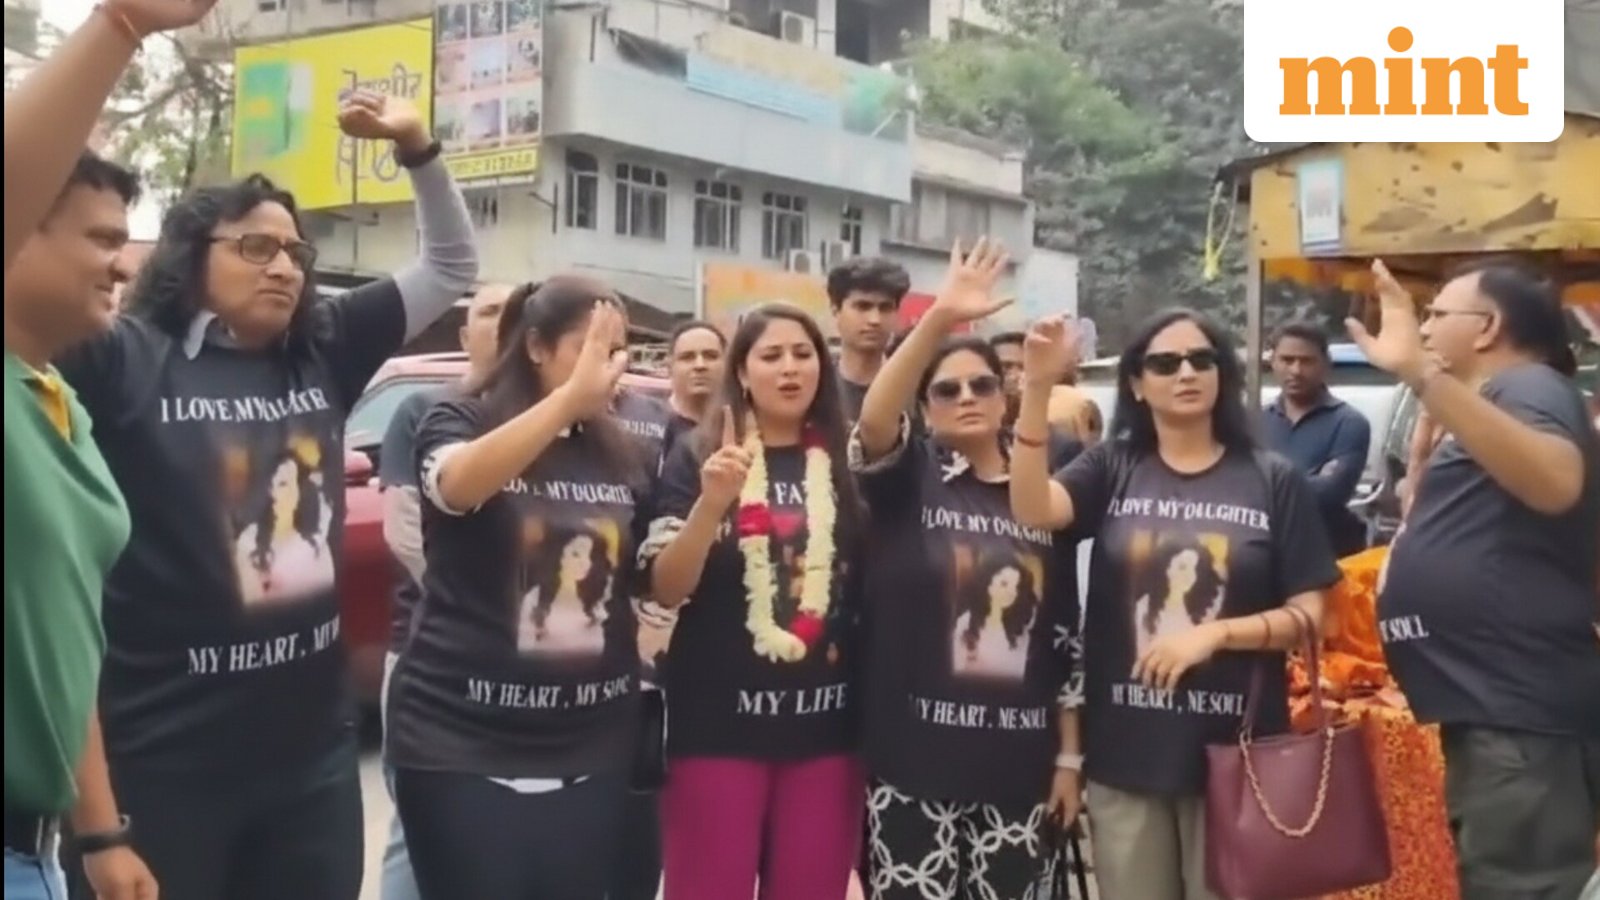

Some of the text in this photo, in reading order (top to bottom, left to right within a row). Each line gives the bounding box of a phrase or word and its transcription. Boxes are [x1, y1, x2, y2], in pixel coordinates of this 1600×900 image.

[161, 397, 170, 423] I
[175, 396, 233, 421] LOVE
[927, 506, 962, 530] LOVE
[1113, 497, 1152, 517] LOVE
[188, 647, 223, 675] MY
[465, 677, 495, 704] MY
[737, 683, 848, 715] MY LIFE
